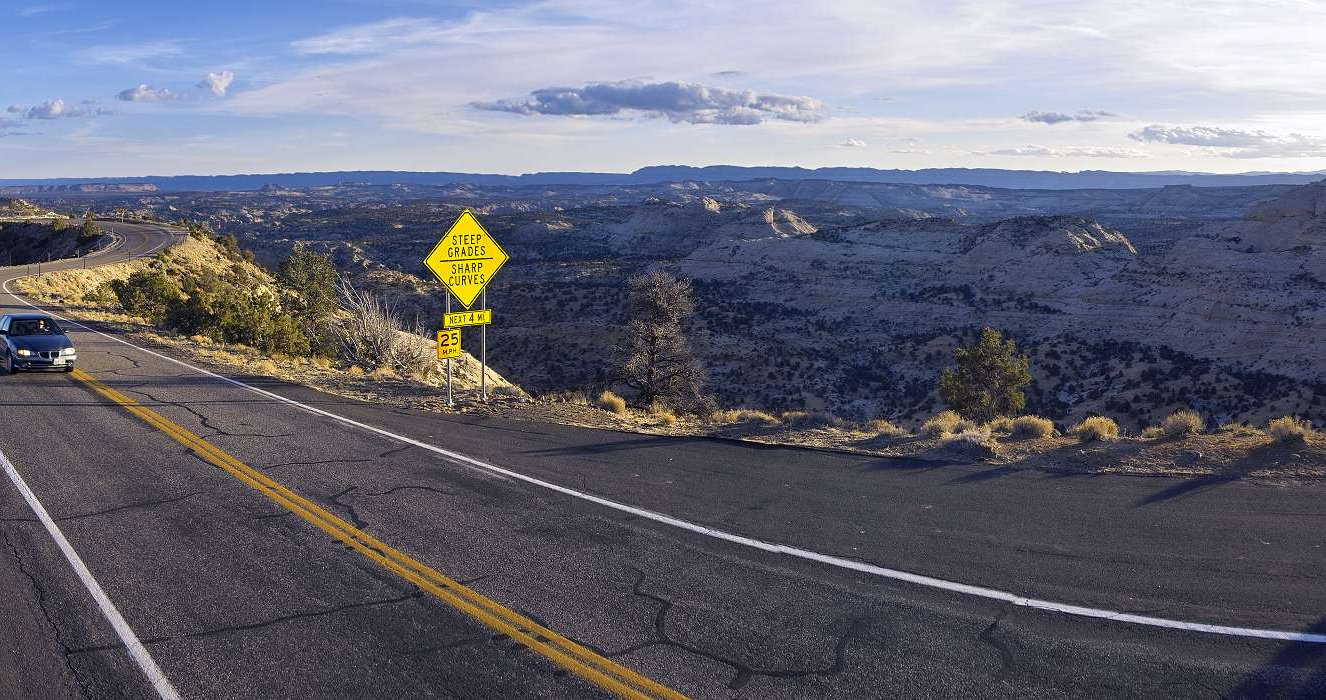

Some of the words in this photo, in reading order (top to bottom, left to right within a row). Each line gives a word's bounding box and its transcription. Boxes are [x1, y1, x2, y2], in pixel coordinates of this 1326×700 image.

[452, 234, 482, 245] STEEP
[448, 246, 486, 257] GRADES
[452, 262, 482, 274] SHARP
[448, 274, 485, 286] CURVES
[450, 315, 466, 324] NEXT
[469, 313, 474, 323] 4
[441, 333, 458, 347] 25
